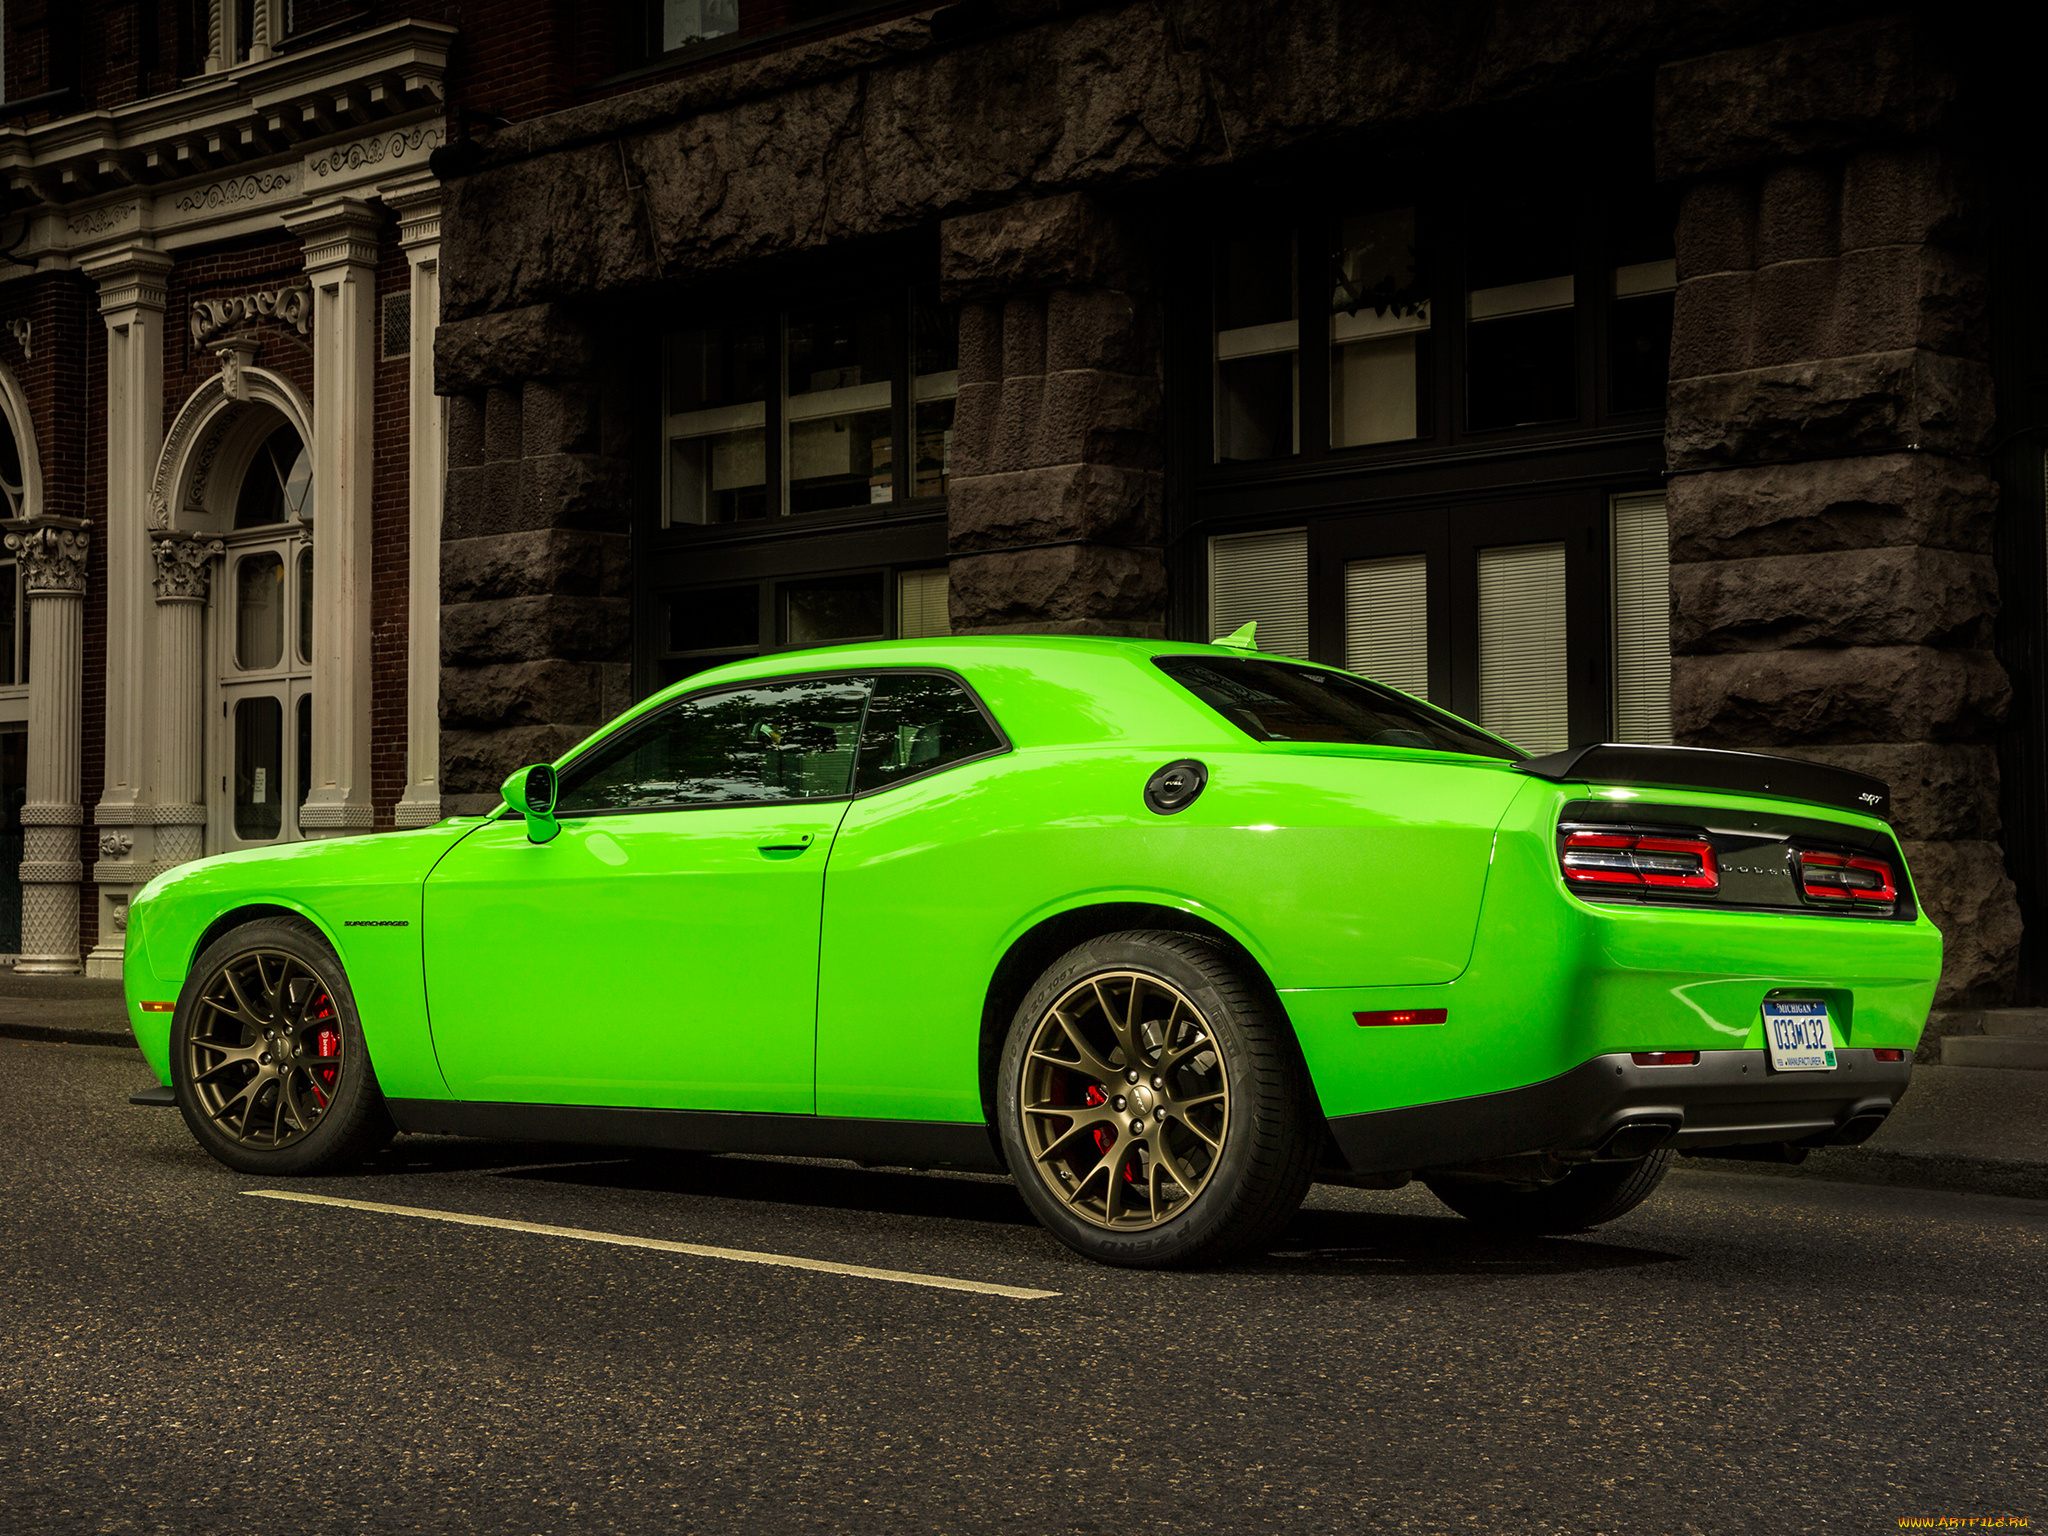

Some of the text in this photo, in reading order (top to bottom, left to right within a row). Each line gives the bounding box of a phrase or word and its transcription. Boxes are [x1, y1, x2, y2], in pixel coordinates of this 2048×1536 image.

[1858, 792, 1883, 806] SRT
[1720, 863, 1791, 876] DODGE
[1047, 964, 1077, 991] 106Y
[1778, 1003, 1812, 1014] MICHIGAN
[1773, 1019, 1827, 1050] 033M132
[1786, 1056, 1823, 1067] MANUFACTURER
[1098, 1231, 1171, 1252] ZERO
